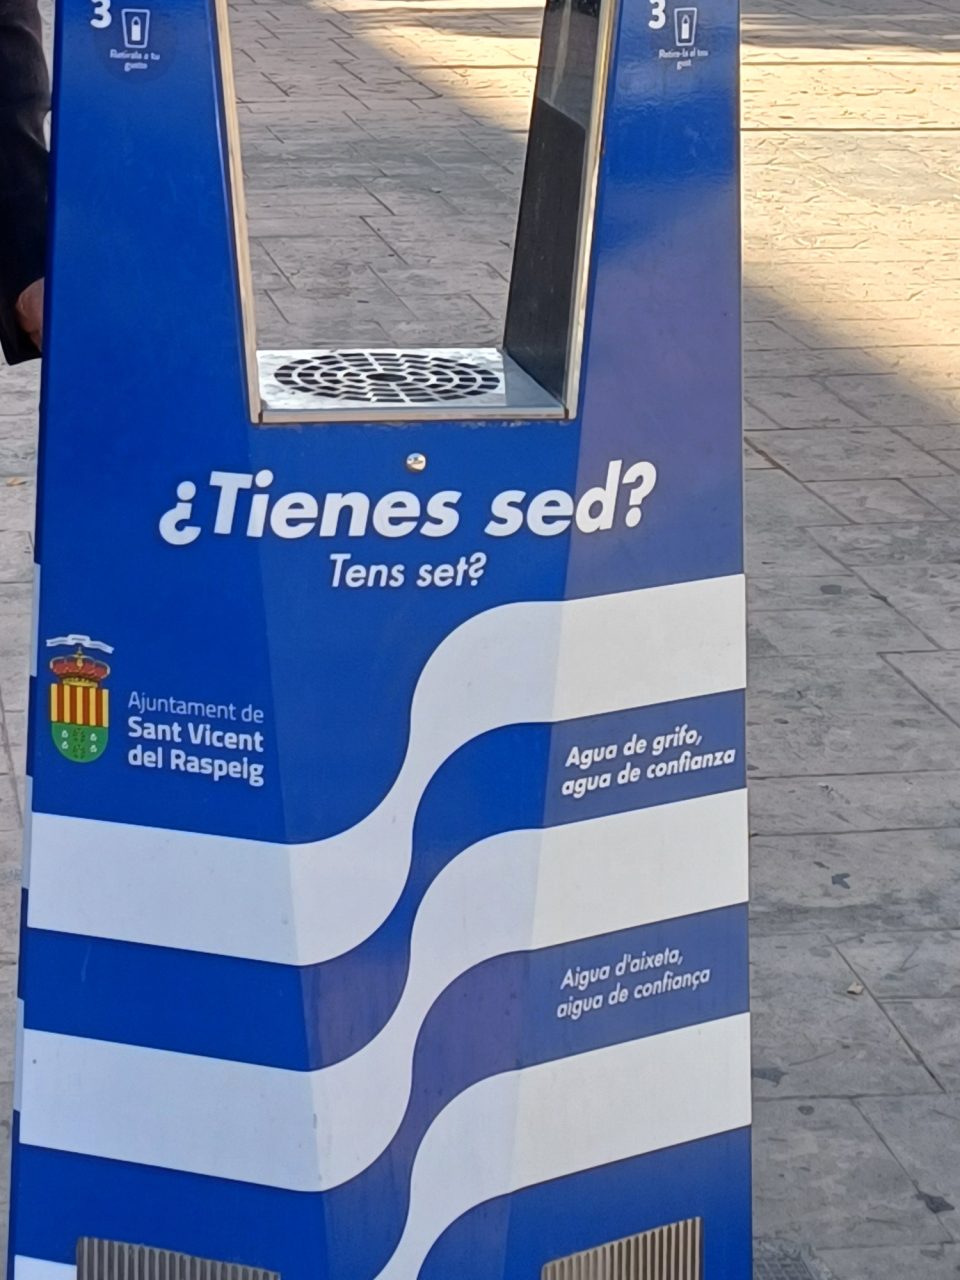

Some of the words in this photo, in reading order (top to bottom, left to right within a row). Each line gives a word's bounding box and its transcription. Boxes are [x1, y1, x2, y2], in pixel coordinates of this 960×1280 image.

[151, 51, 161, 61] tu
[158, 469, 462, 546] ¿Tienes
[484, 458, 658, 538] sed?
[328, 552, 405, 588] Tens
[416, 551, 487, 588] set?
[127, 691, 236, 721] Ajuntament
[241, 704, 265, 724] de
[127, 716, 182, 743] Sant
[188, 722, 265, 753] Vicent
[565, 744, 618, 770] Agua
[623, 733, 647, 756] de
[652, 723, 703, 756] grifo,
[127, 744, 163, 769] del
[170, 749, 265, 787] Raspeig
[561, 773, 611, 799] agua
[617, 762, 641, 785] de
[646, 749, 737, 779] confianza
[560, 964, 611, 991] Aigua
[615, 947, 684, 977] d'aixeta,
[556, 995, 603, 1020] aigua
[608, 982, 629, 1005] de
[633, 969, 711, 999] confiança
